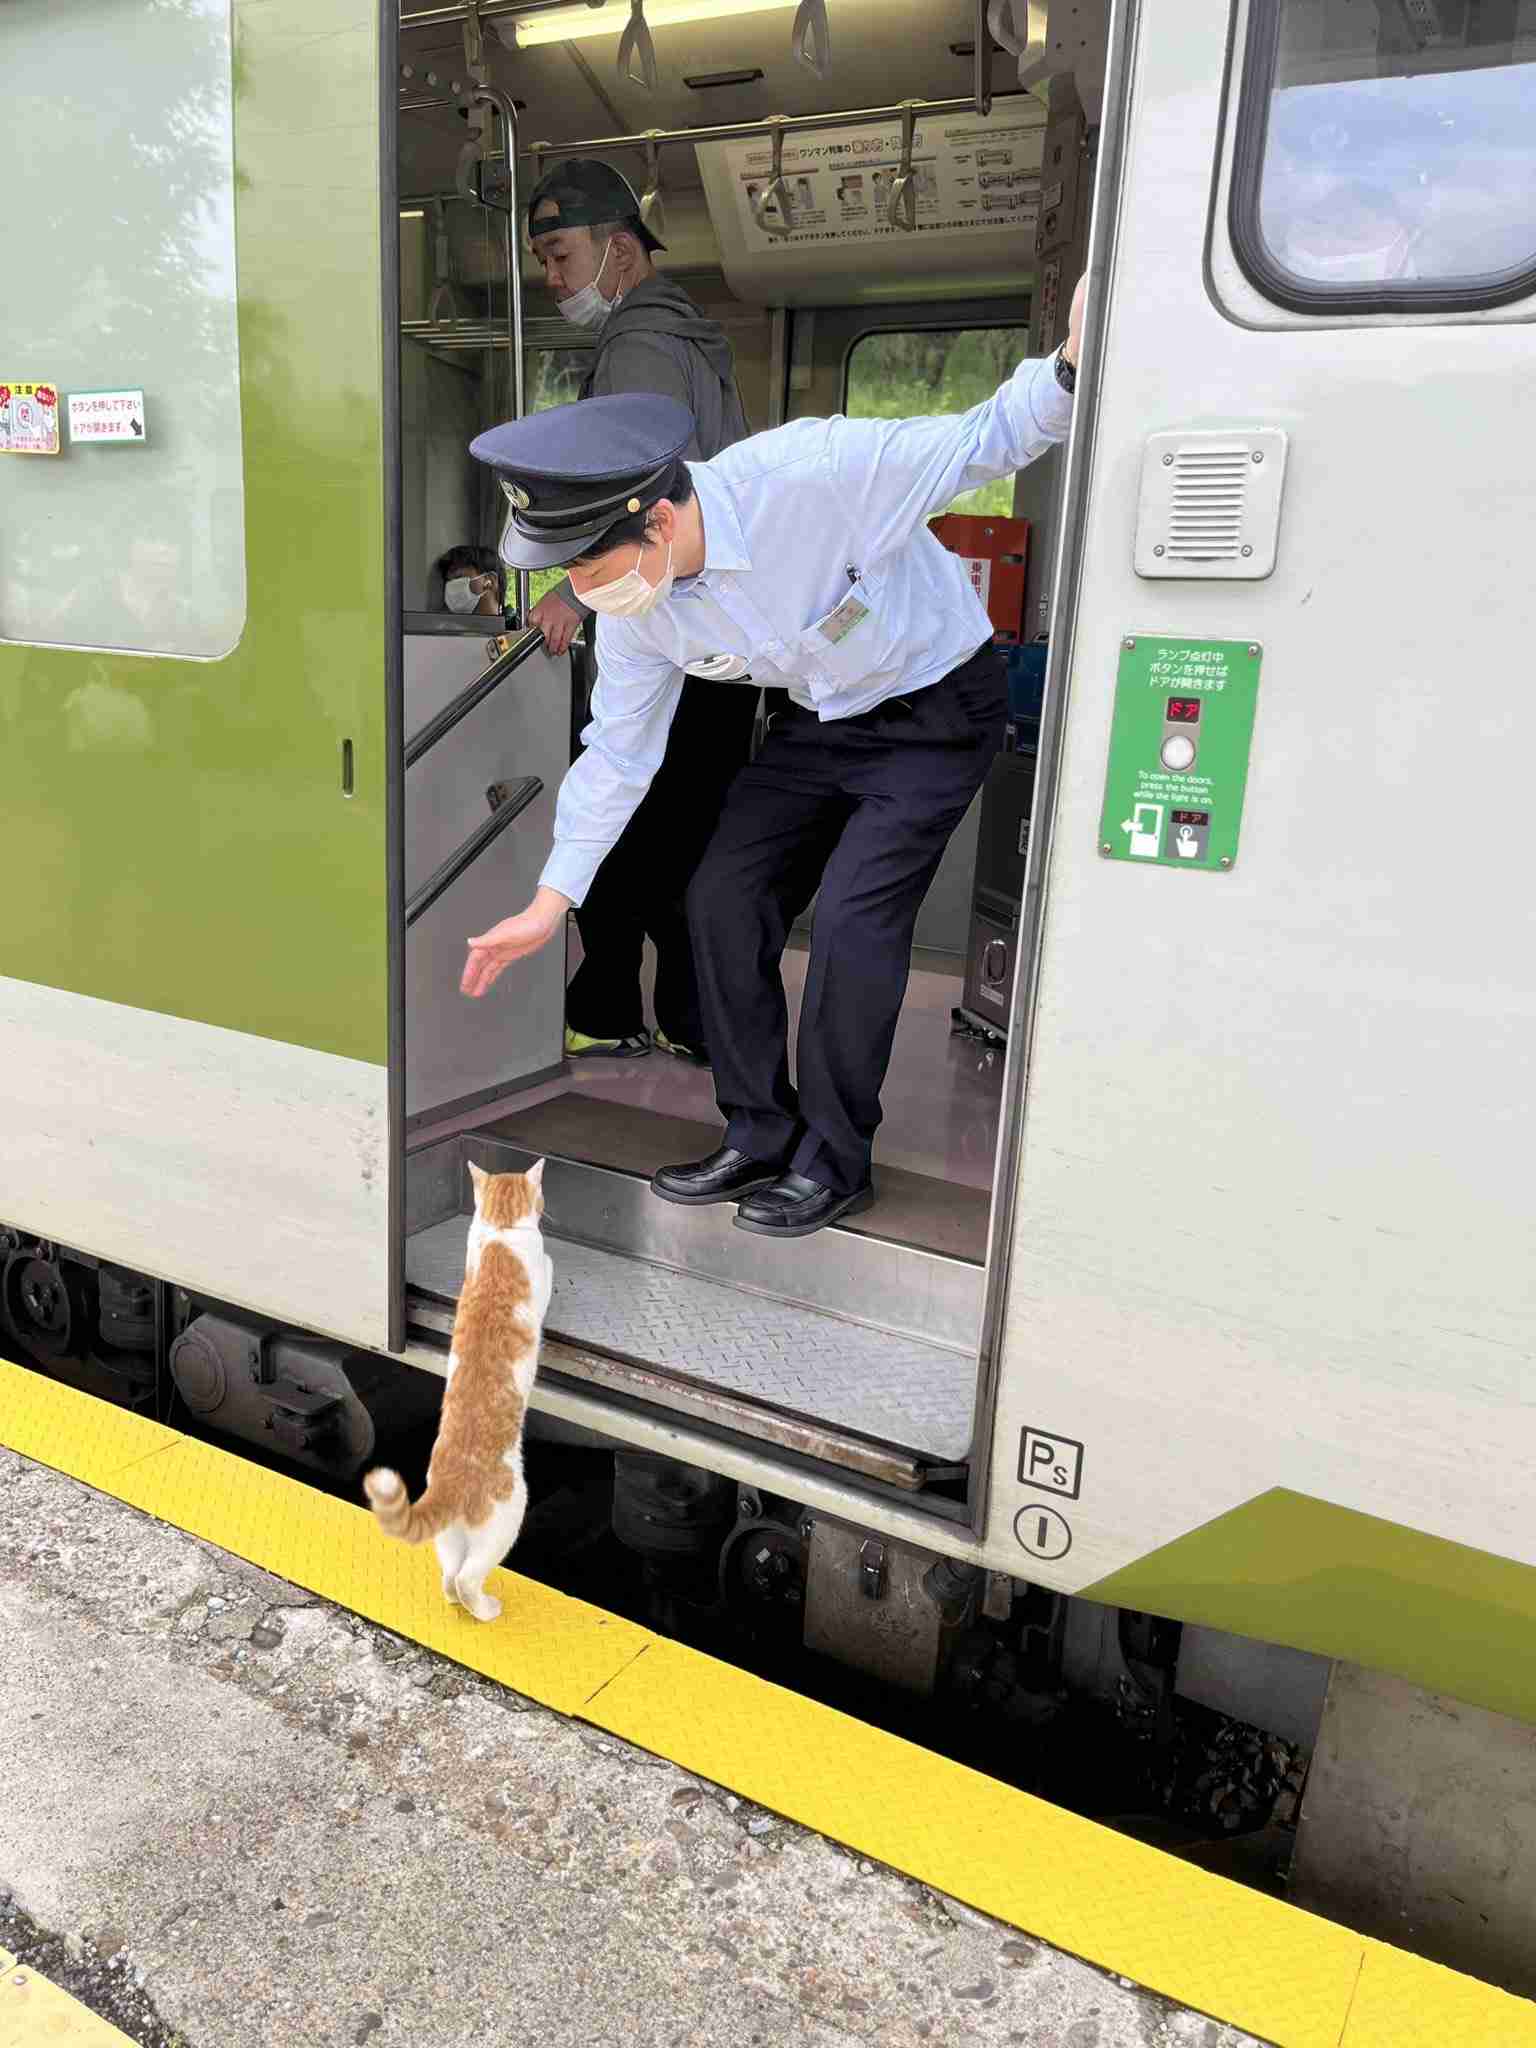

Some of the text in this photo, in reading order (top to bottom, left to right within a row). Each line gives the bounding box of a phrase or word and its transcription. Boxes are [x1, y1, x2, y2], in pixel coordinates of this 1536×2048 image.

[1158, 649, 1225, 663] ランプ点灯中
[1150, 662, 1229, 677] ボタンを押せば
[1150, 676, 1225, 691] ドアが開きます
[1170, 702, 1198, 718] ドア
[1138, 770, 1149, 780] To
[1150, 774, 1170, 784] open
[1172, 775, 1185, 783] the
[1140, 782, 1209, 794] press the button
[1133, 790, 1154, 799] while
[1155, 792, 1169, 800] the
[1170, 792, 1189, 803] light
